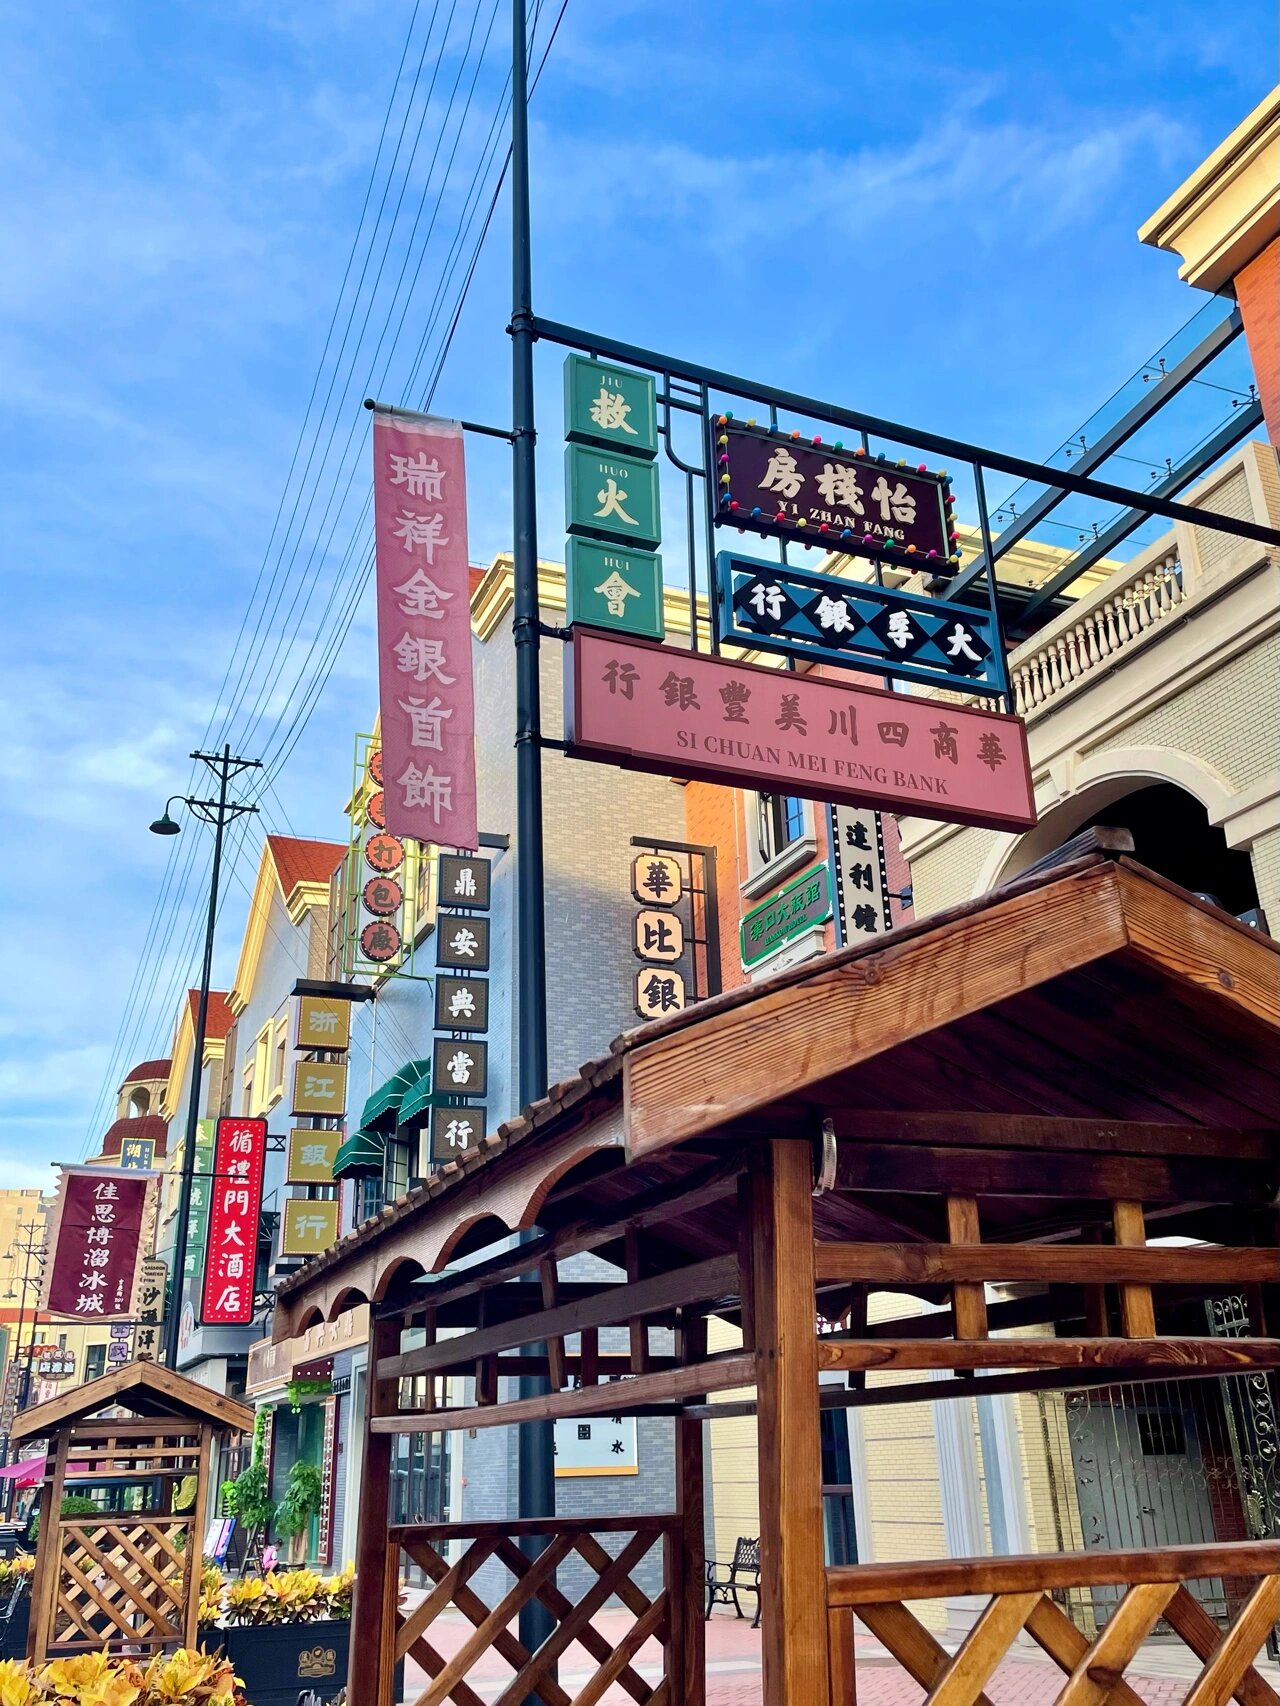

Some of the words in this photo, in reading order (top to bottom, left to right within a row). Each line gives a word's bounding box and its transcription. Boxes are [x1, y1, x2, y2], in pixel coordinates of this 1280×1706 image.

[600, 375, 624, 389] JIU
[599, 463, 630, 480] HUO
[777, 500, 799, 516] YI
[809, 507, 857, 529] ZHAN
[862, 520, 906, 541] FANG
[603, 556, 630, 571] HUI
[389, 450, 458, 826] 瑞祥金銀首飾
[676, 730, 698, 750] SI
[703, 735, 781, 765] CHUAN
[787, 750, 828, 774] MEI
[833, 759, 888, 784] FENG
[893, 770, 950, 795] BANK
[642, 860, 681, 1013] 華比銀
[444, 867, 479, 1150] 鼎安典當行
[294, 1010, 341, 1240] 浙江銀行
[75, 1181, 120, 1314] 佳思博溜冰城
[215, 1129, 254, 1313] 循禮門大酒店
